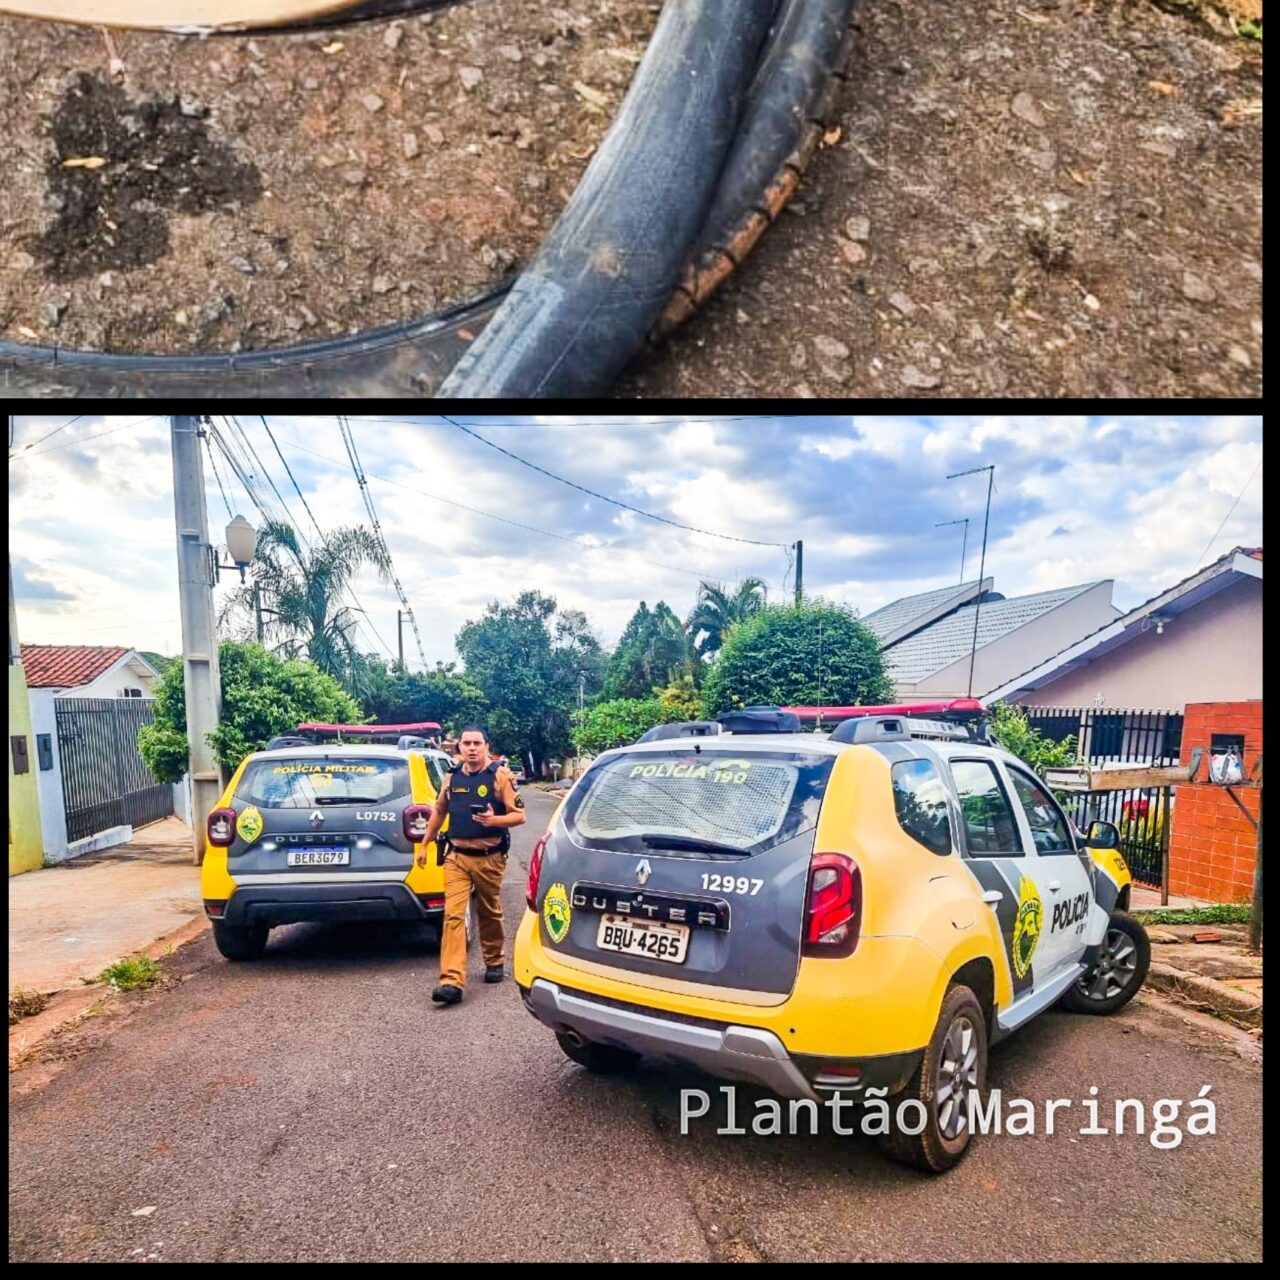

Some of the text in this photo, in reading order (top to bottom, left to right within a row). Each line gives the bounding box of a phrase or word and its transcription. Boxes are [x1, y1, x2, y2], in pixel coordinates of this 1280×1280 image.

[325, 764, 375, 774] MILITAR
[713, 770, 748, 784] 190
[356, 811, 396, 822] L0752
[275, 834, 359, 842] DUSTER
[294, 852, 344, 864] BER3G79
[701, 873, 764, 896] 12997
[572, 894, 717, 925] DUSTER
